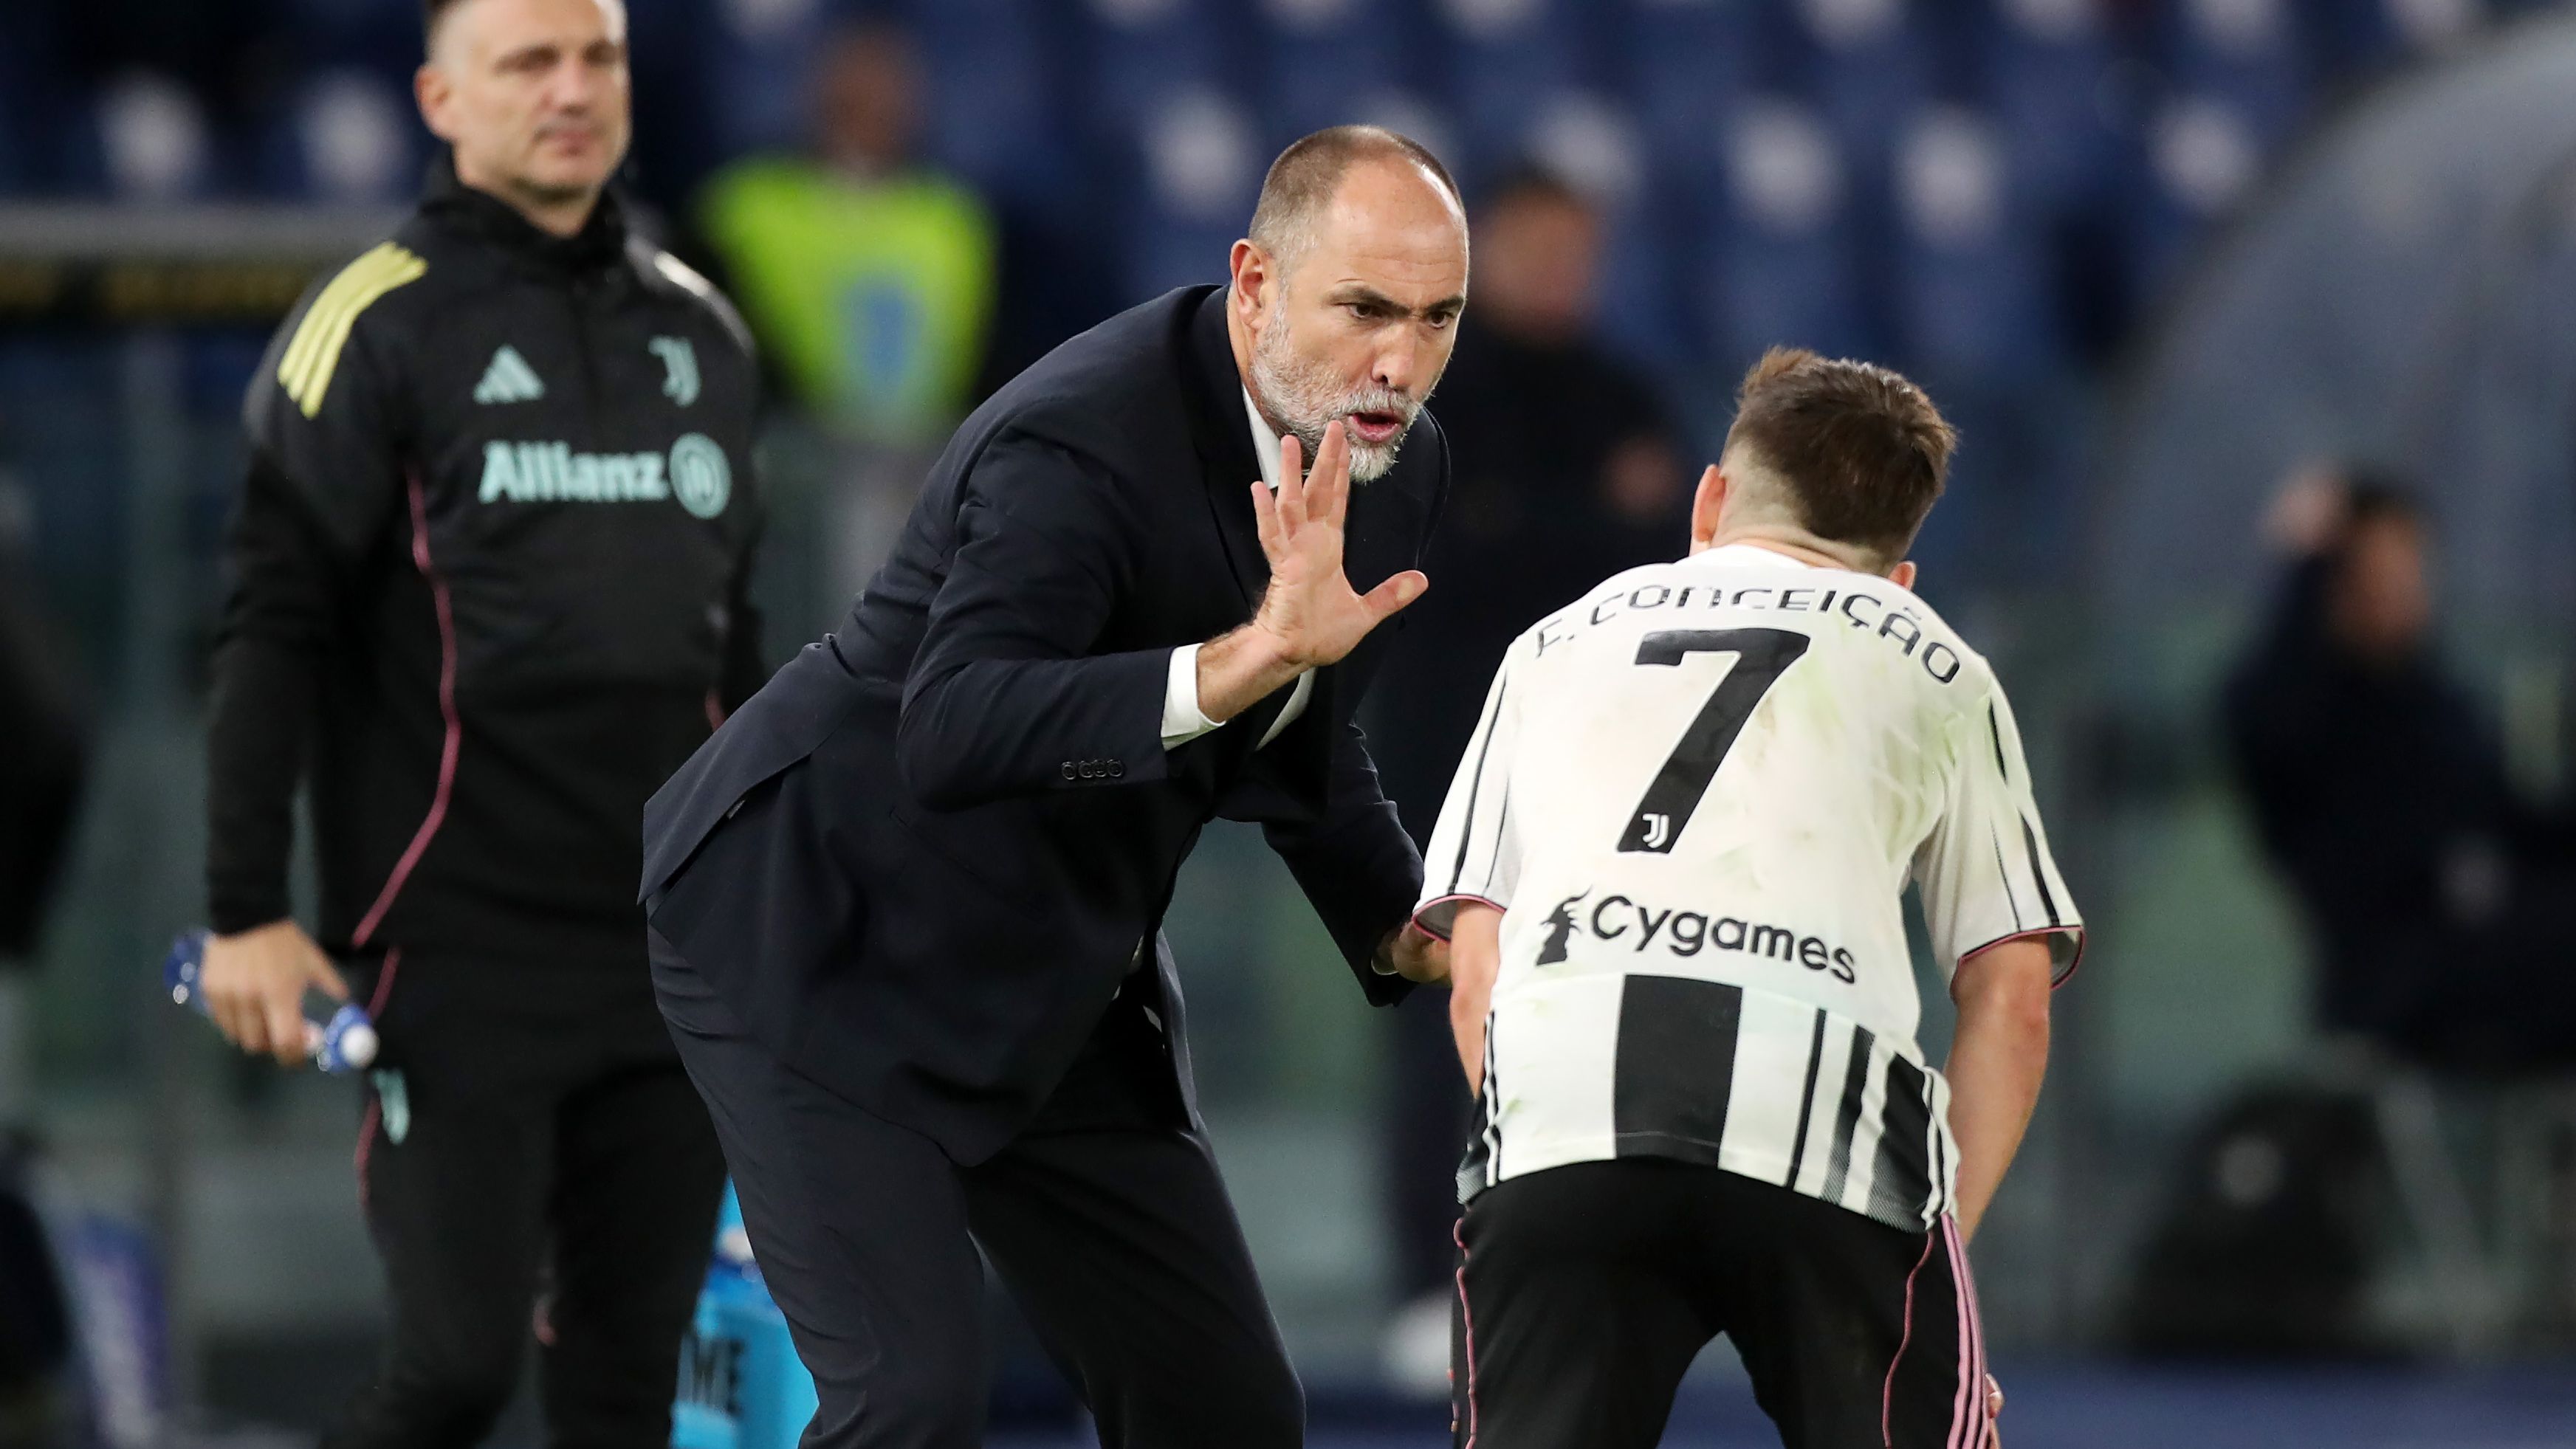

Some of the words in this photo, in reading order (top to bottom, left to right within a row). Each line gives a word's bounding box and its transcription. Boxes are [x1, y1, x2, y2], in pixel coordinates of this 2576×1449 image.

[478, 440, 670, 504] Allianz
[1536, 618, 1575, 658] F.
[1616, 627, 1811, 854] 7
[1591, 895, 1855, 984] Cygames
